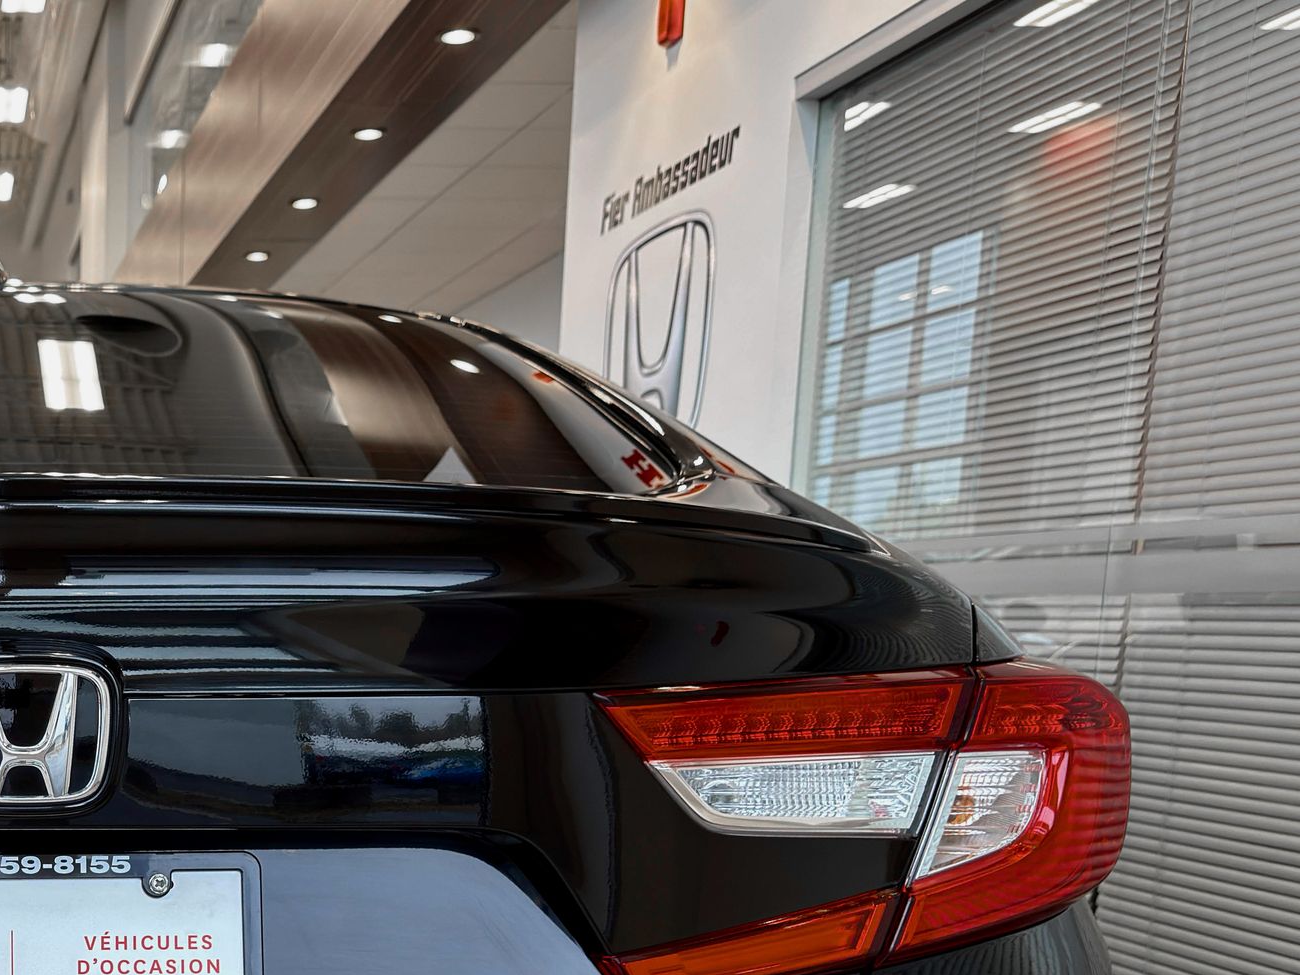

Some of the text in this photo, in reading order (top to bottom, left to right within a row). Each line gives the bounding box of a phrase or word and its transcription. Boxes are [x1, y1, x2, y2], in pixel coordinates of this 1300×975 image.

[601, 124, 741, 235] Fier Ambassadeur
[83, 931, 214, 951] VÉHICULES
[77, 958, 221, 975] D'OCCASION
